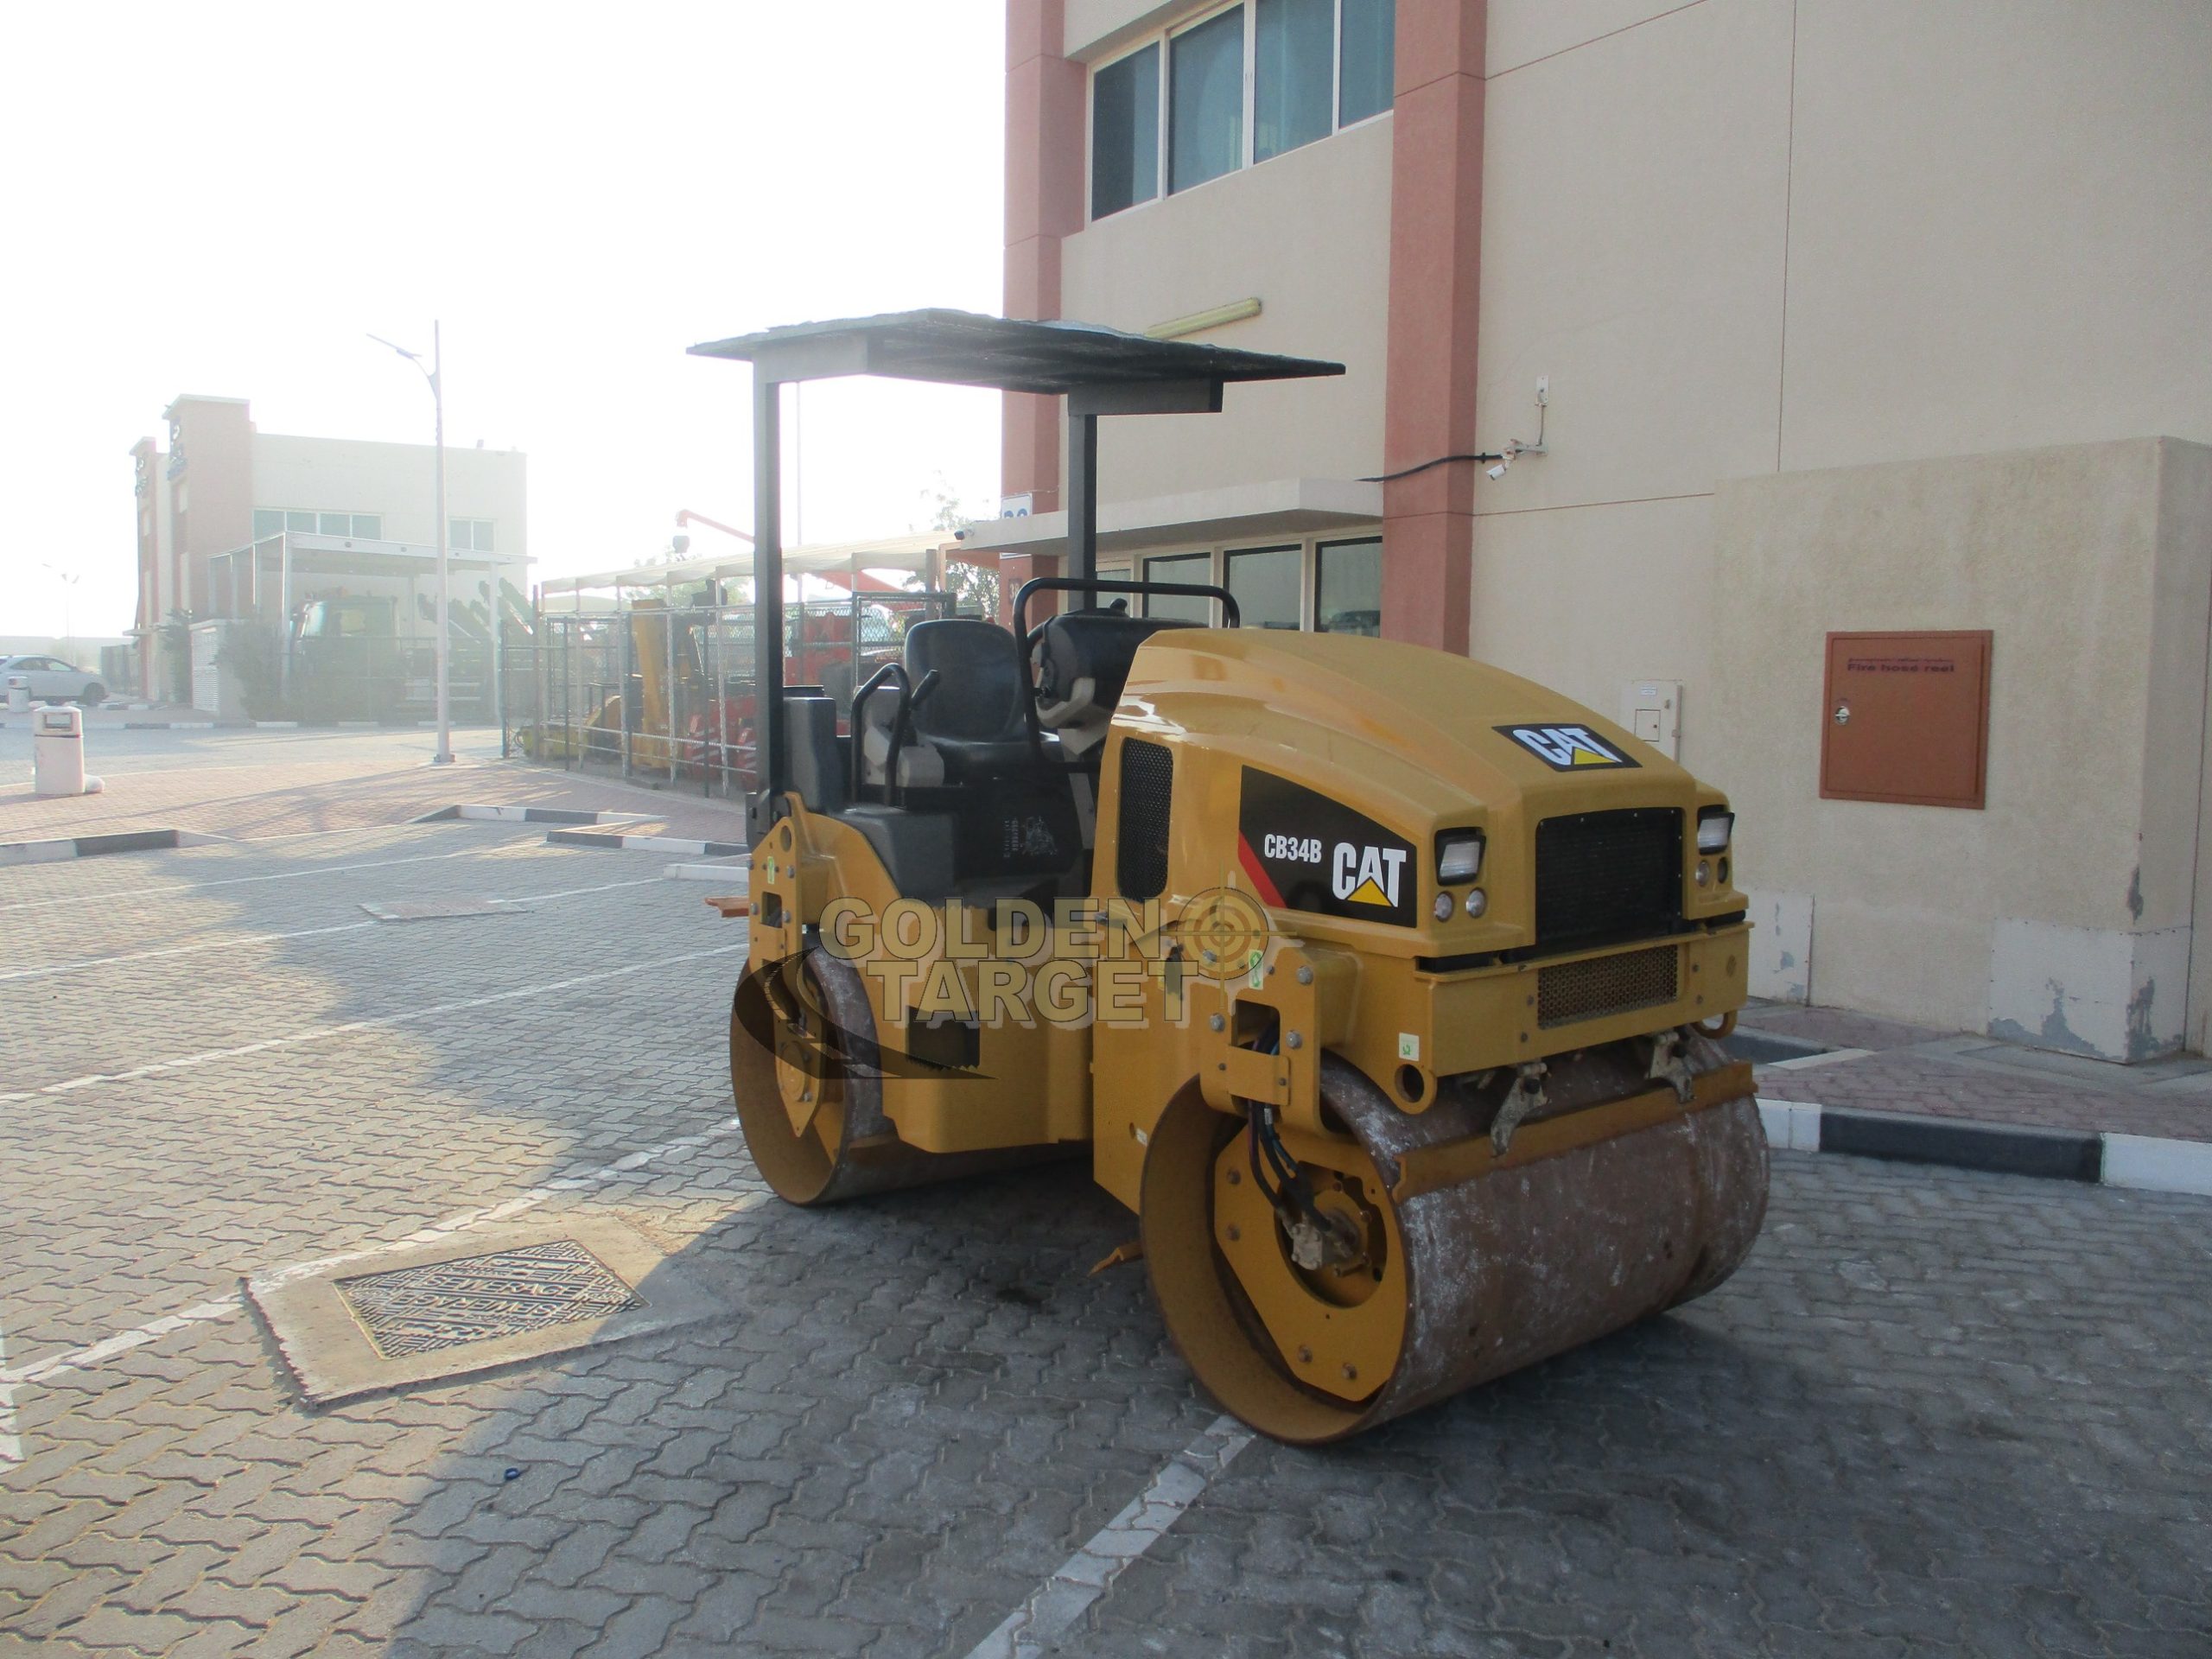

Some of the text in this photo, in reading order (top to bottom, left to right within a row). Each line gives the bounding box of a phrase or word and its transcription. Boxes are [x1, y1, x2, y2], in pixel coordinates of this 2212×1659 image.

[1847, 663, 1955, 672] Fire hose reel
[1512, 728, 1623, 766] CAT
[1264, 834, 1322, 863] CB34B
[1332, 842, 1407, 907] CAT
[424, 1274, 586, 1297] SEWERAGE
[391, 1294, 557, 1317] SEWERAGE
